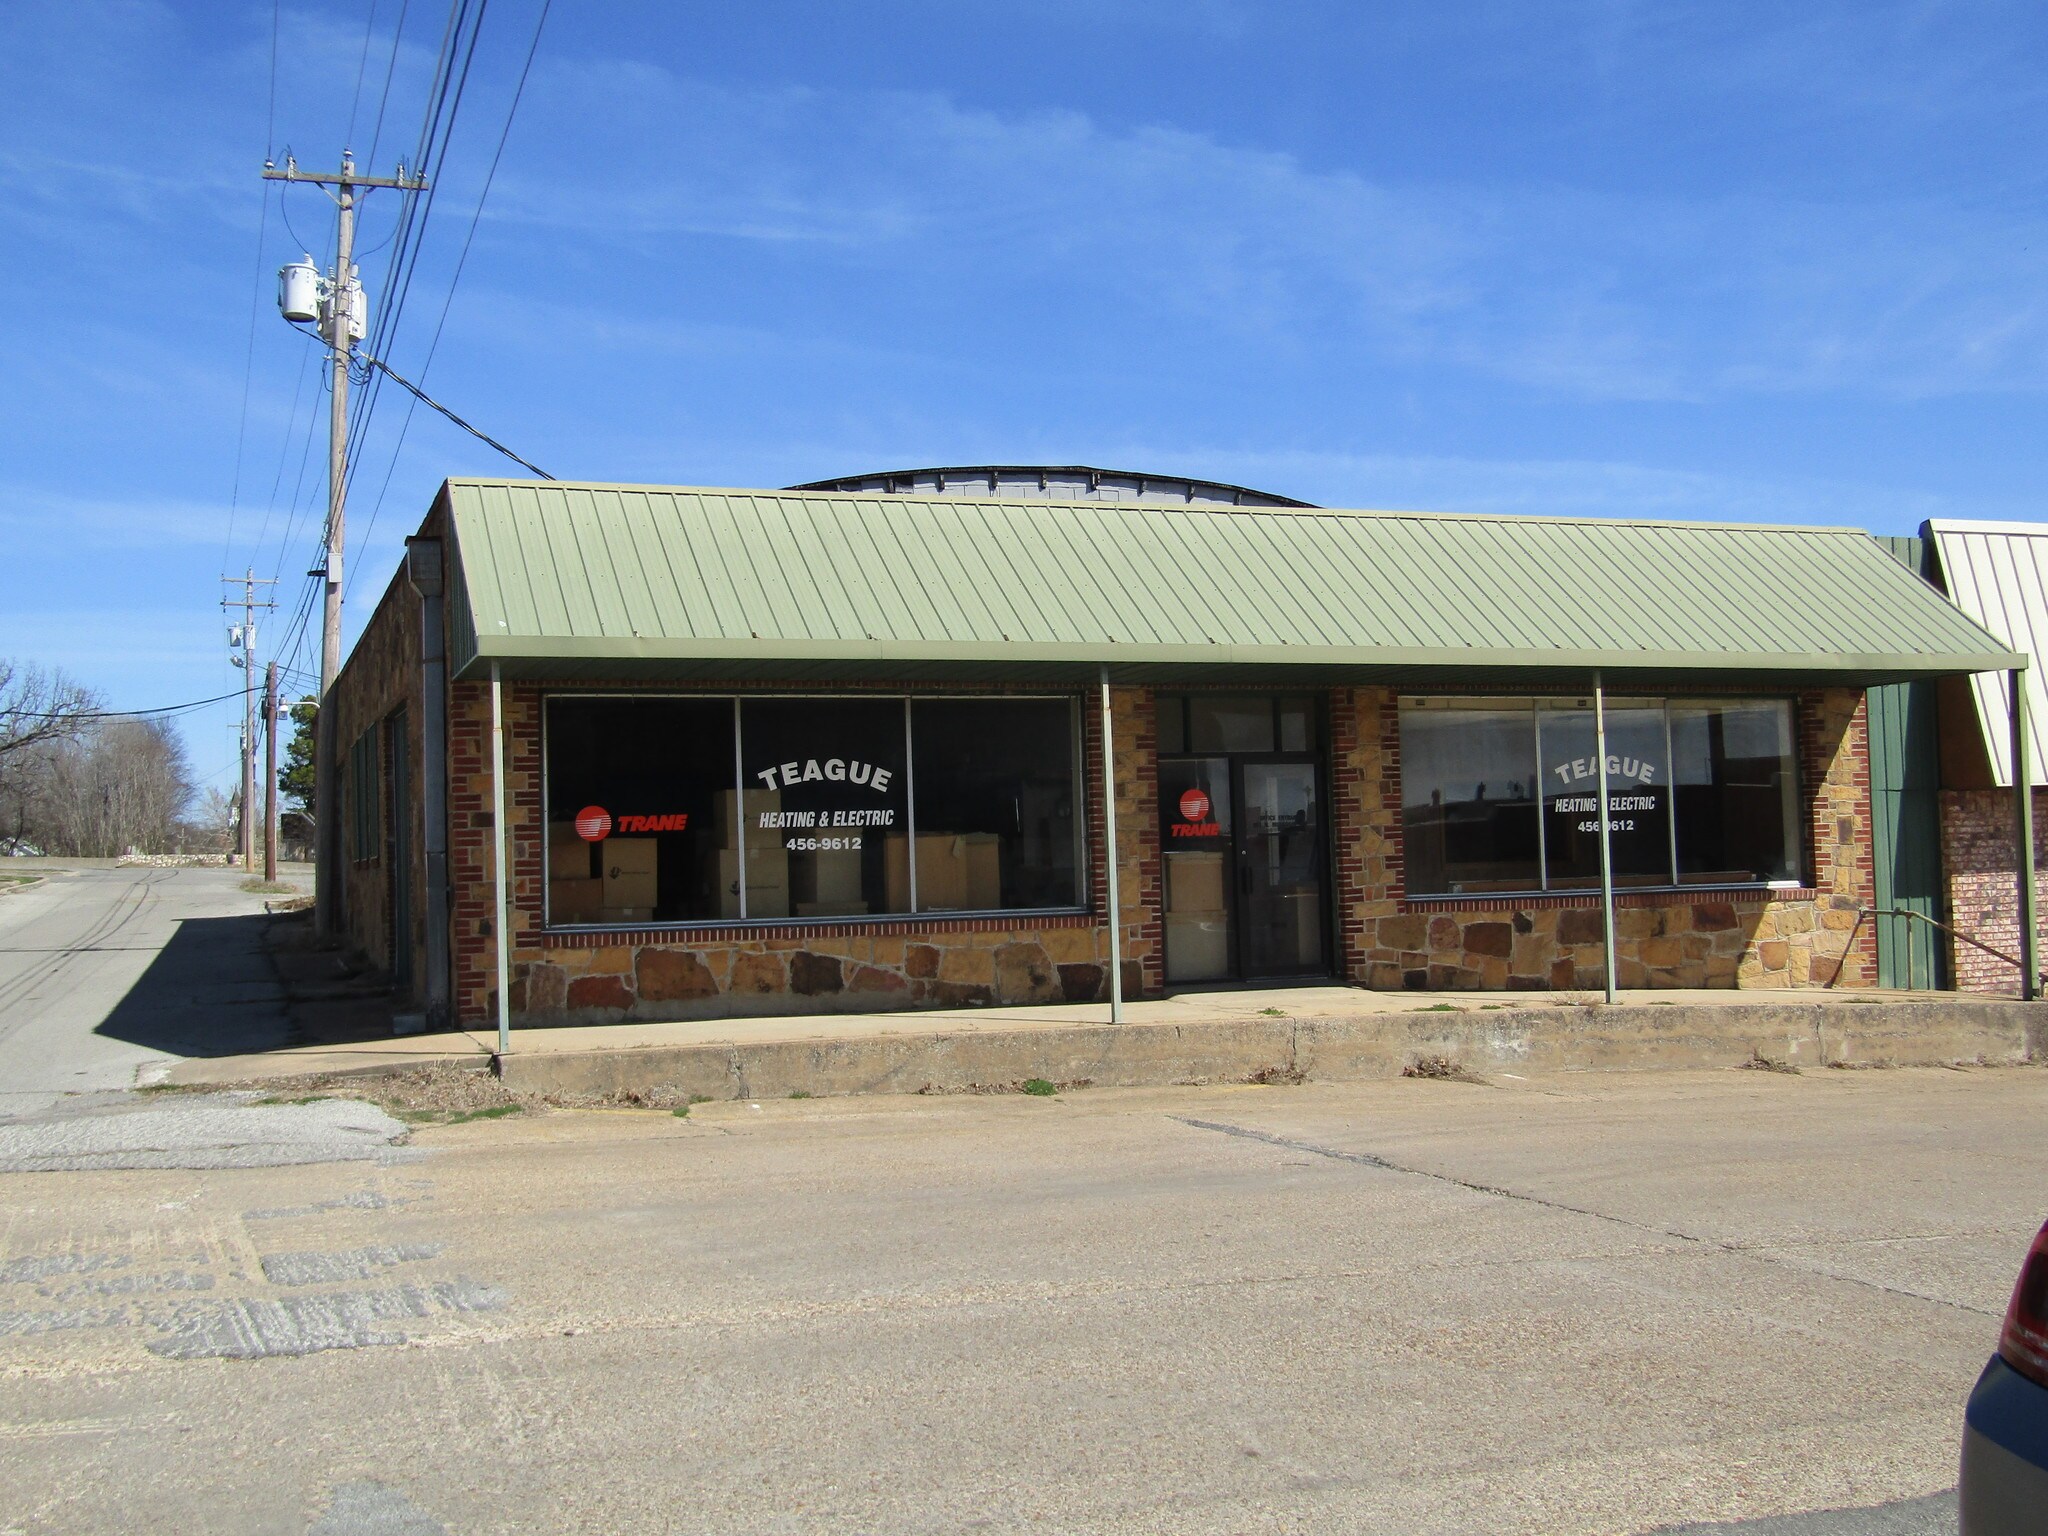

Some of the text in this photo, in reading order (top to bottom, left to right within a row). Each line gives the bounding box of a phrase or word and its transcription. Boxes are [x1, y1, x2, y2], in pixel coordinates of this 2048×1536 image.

[757, 758, 892, 792] TEAGUE
[1555, 795, 1655, 812] HEATING ELECTRIC
[618, 814, 688, 832] TRANE
[759, 809, 894, 828] HEATING & ELECTRIC
[1577, 819, 1634, 832] 456612
[1171, 822, 1220, 837] TRANE
[786, 836, 862, 850] 456-9612
